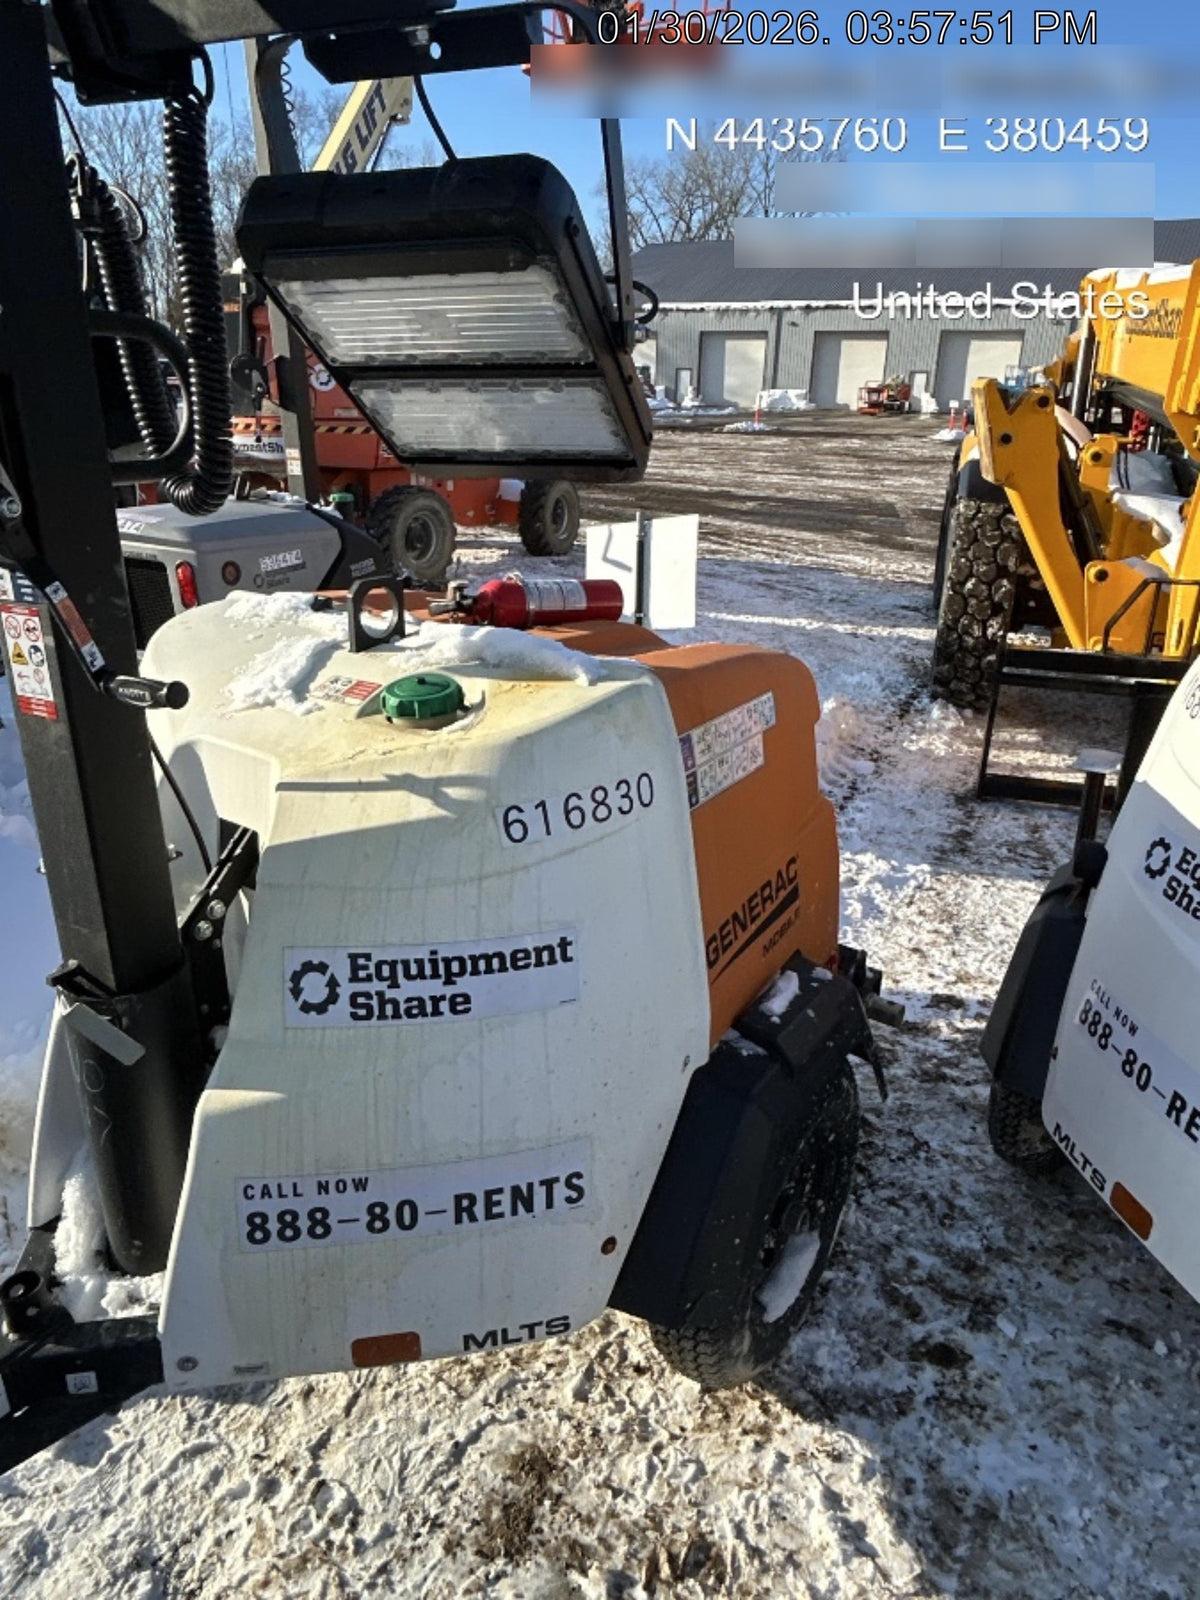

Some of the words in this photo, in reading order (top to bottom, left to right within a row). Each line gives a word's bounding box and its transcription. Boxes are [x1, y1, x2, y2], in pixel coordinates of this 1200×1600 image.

[355, 81, 387, 152] LIFT
[503, 772, 654, 844] 616830
[706, 855, 798, 969] GENERAC
[348, 936, 574, 989] Equipment
[349, 990, 473, 1022] Share
[1091, 978, 1111, 1010] CALL
[1112, 1006, 1139, 1037] NOW
[243, 1182, 304, 1200] CALL
[316, 1177, 370, 1196] NOW
[1053, 1121, 1107, 1193] MLTS
[245, 1170, 586, 1245] 888-80-RENTS
[462, 1315, 572, 1351] MLTS
